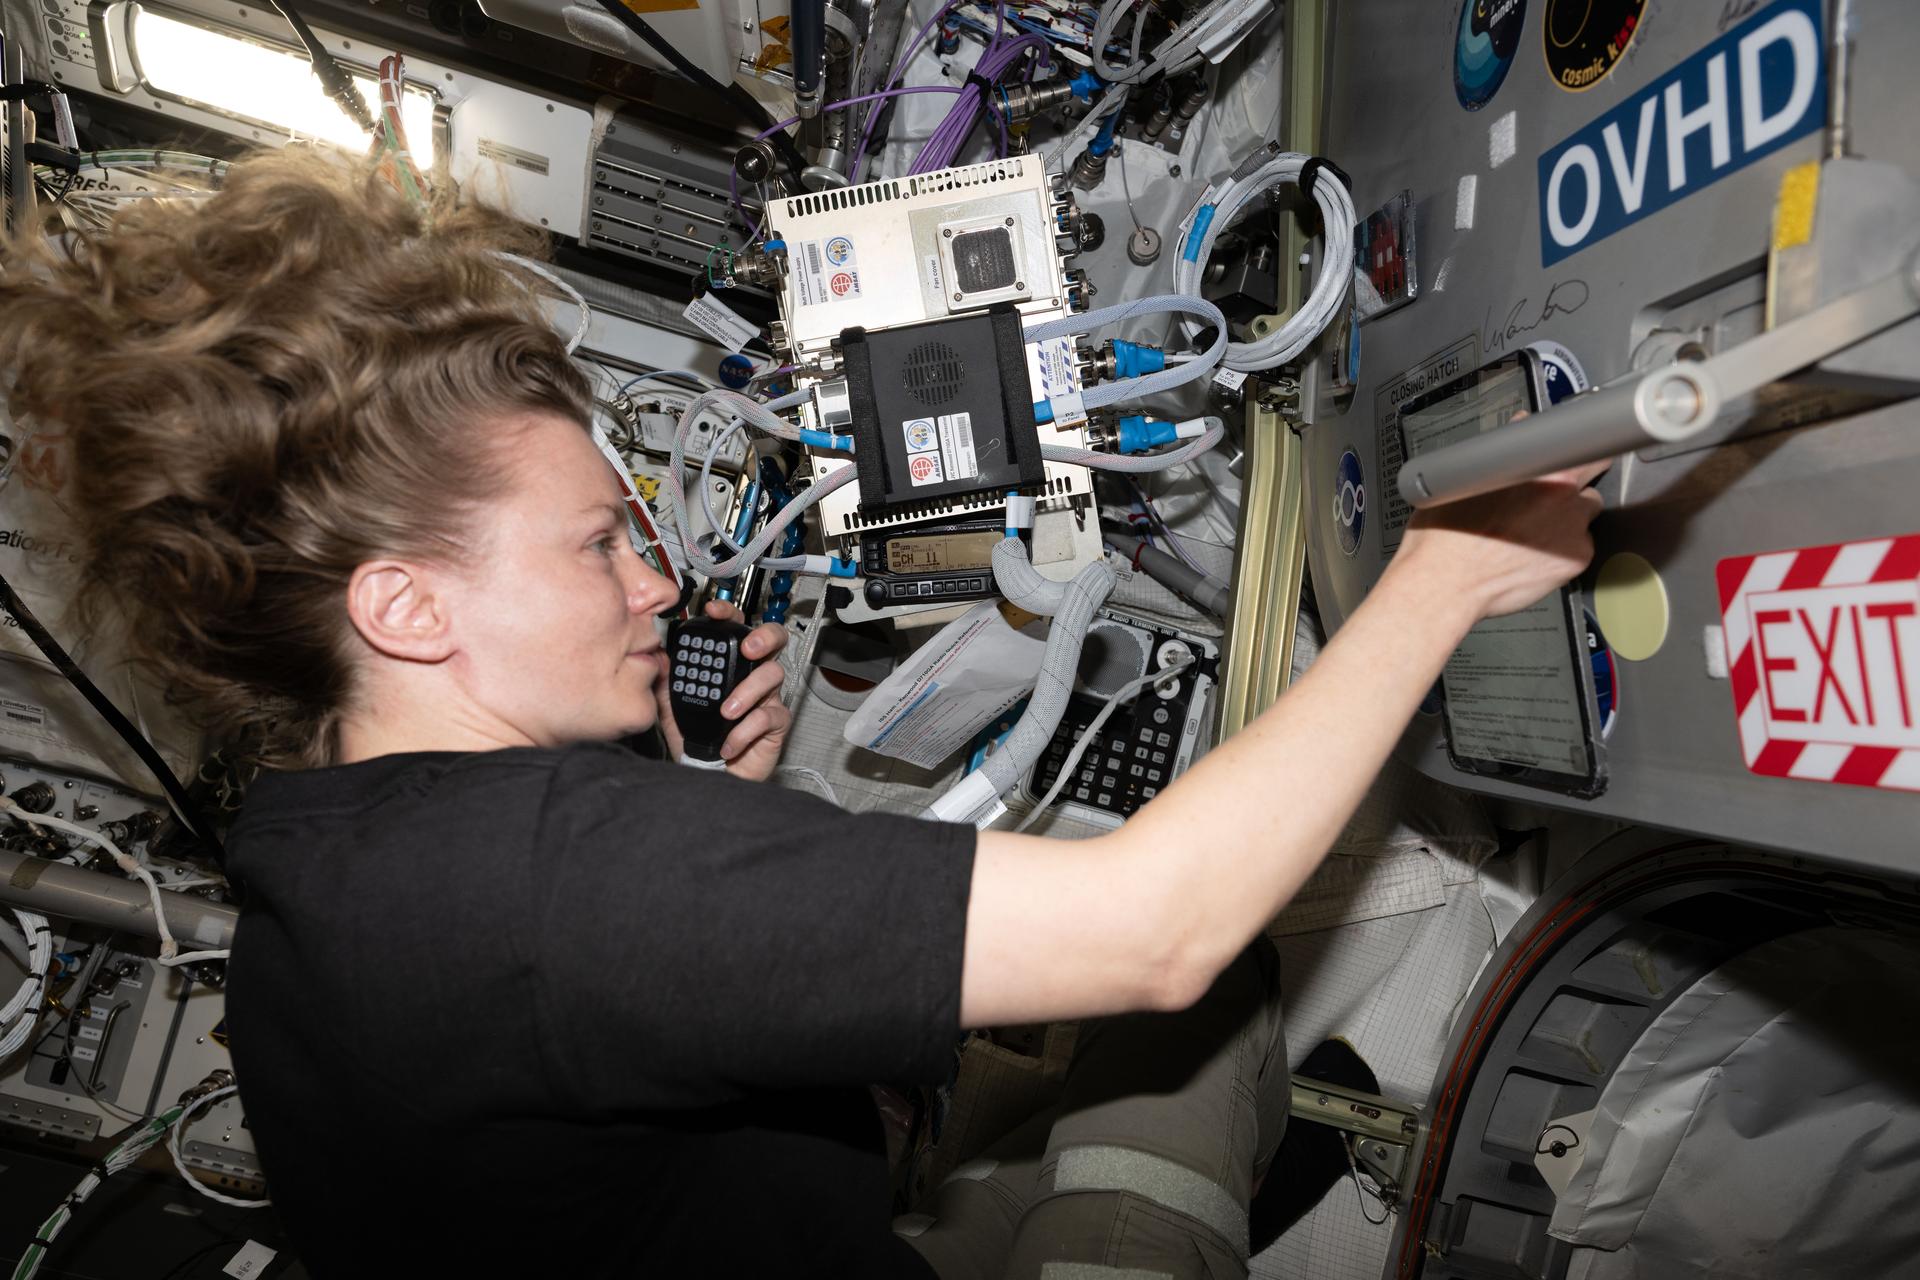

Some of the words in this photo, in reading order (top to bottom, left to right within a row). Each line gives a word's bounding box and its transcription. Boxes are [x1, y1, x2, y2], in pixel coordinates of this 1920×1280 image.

[1561, 56, 1605, 86] cosmic
[1607, 14, 1637, 61] kiss
[1546, 9, 1818, 248] OVHD
[852, 272, 860, 292] AMSAT
[721, 364, 751, 379] NASA
[1044, 351, 1052, 381] ATTENTION
[1390, 376, 1425, 406] CLOSING
[1426, 356, 1460, 386] HATCH
[664, 398, 686, 407] LOCKER
[932, 455, 940, 478] AMSAT
[901, 554, 914, 564] CH
[926, 552, 937, 562] 11
[1112, 614, 1130, 624] AUDIO
[1132, 619, 1158, 632] TERMINAL
[1161, 628, 1174, 637] UNIT
[897, 681, 919, 702] Kenwood
[916, 664, 934, 682] D710GA
[957, 619, 980, 640] Reference
[1755, 602, 1916, 728] EXIT
[682, 696, 709, 706] KENWOOD
